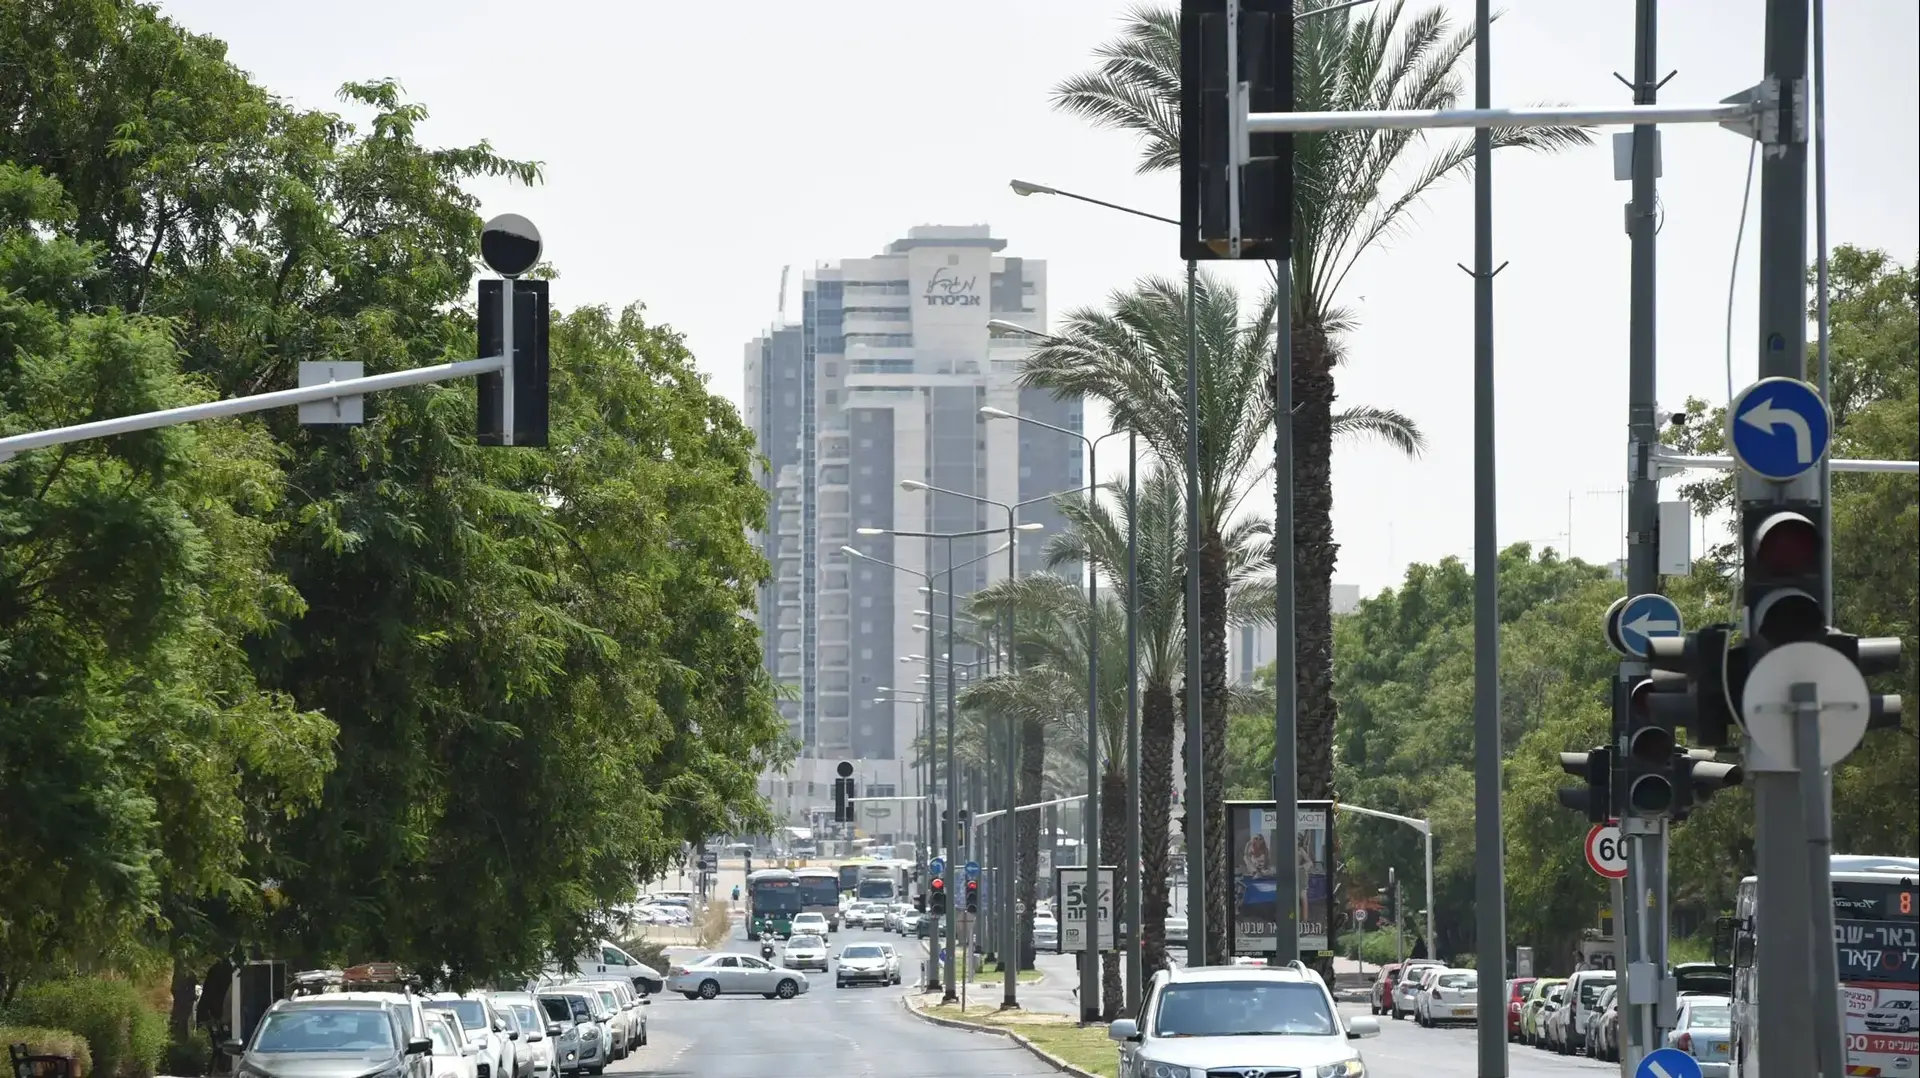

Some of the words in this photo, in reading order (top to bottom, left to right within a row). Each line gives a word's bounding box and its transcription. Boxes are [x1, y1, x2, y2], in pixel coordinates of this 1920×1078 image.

[1599, 837, 1628, 861] 60
[1900, 891, 1911, 914] 8
[1832, 925, 1917, 947] באר-שב
[1873, 1040, 1885, 1049] 17
